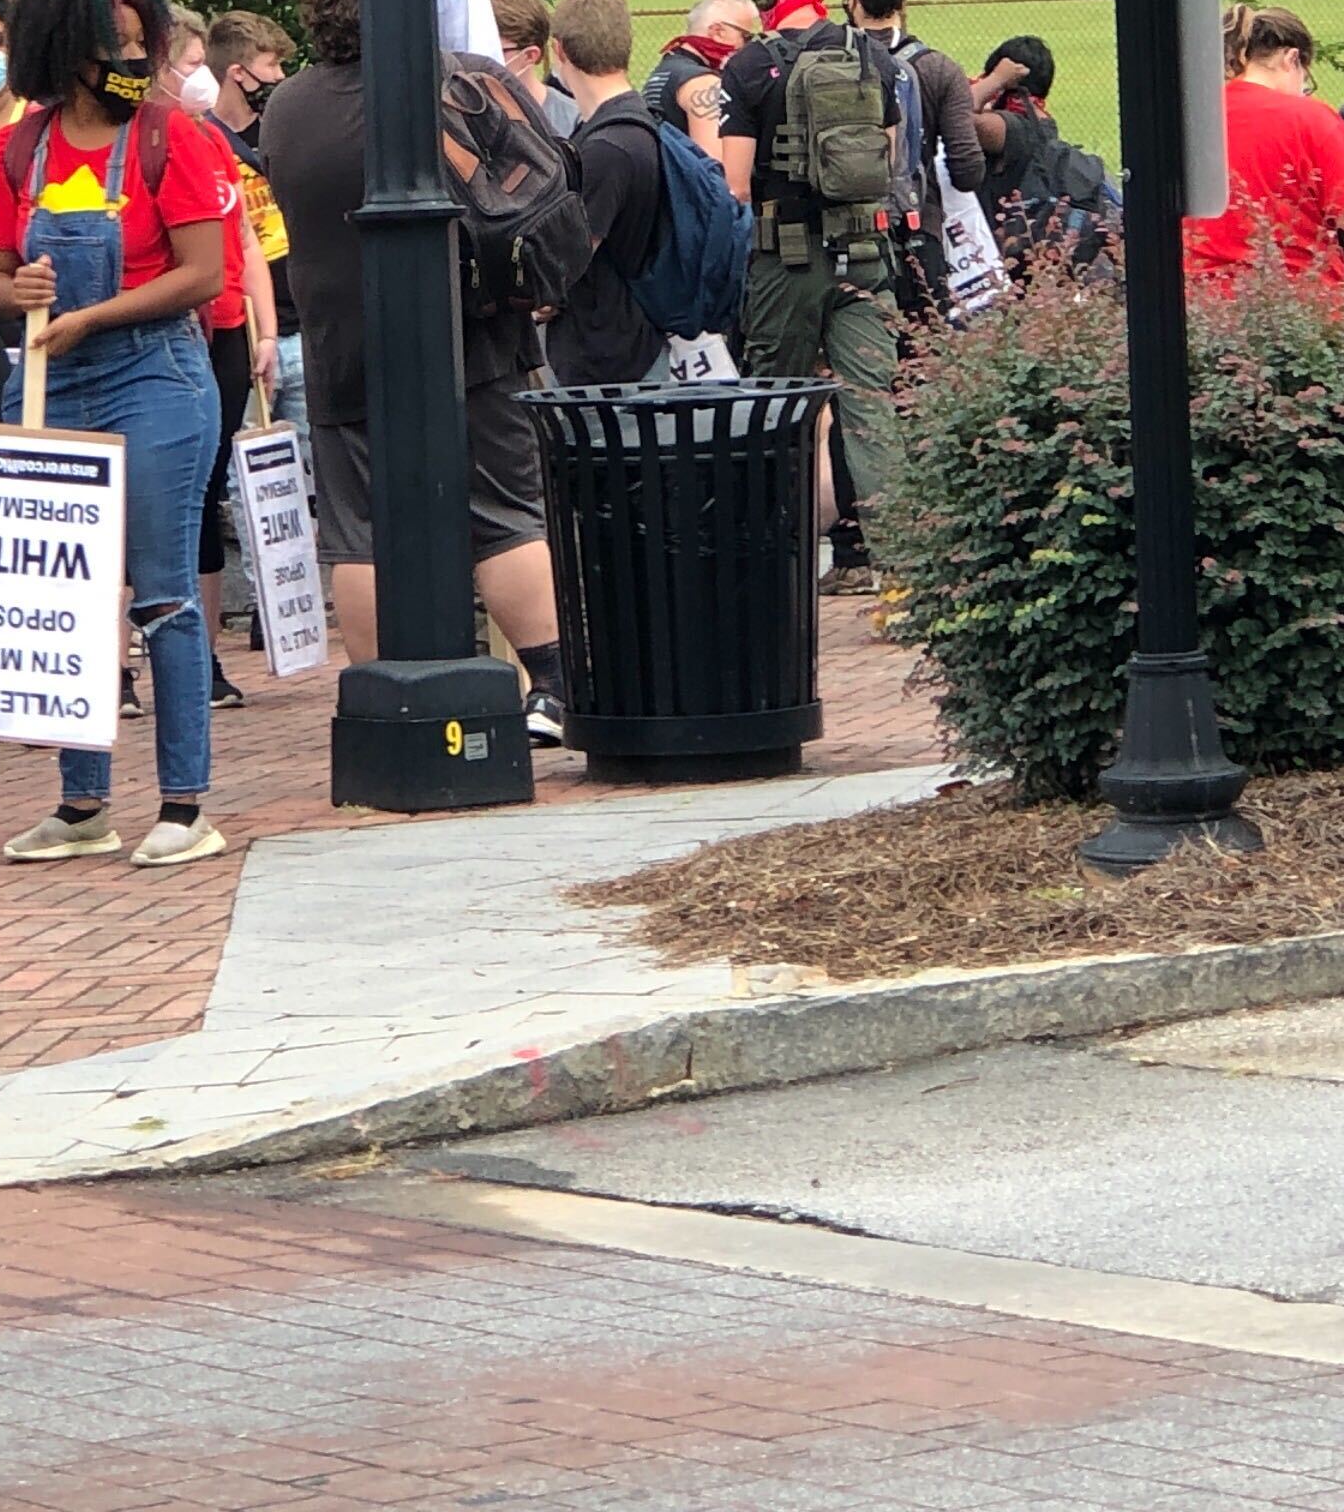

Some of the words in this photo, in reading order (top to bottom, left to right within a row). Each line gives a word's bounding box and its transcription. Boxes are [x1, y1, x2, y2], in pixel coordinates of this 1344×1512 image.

[259, 508, 305, 546] WHITE
[31, 650, 83, 677] STN
[446, 720, 462, 756] 9
